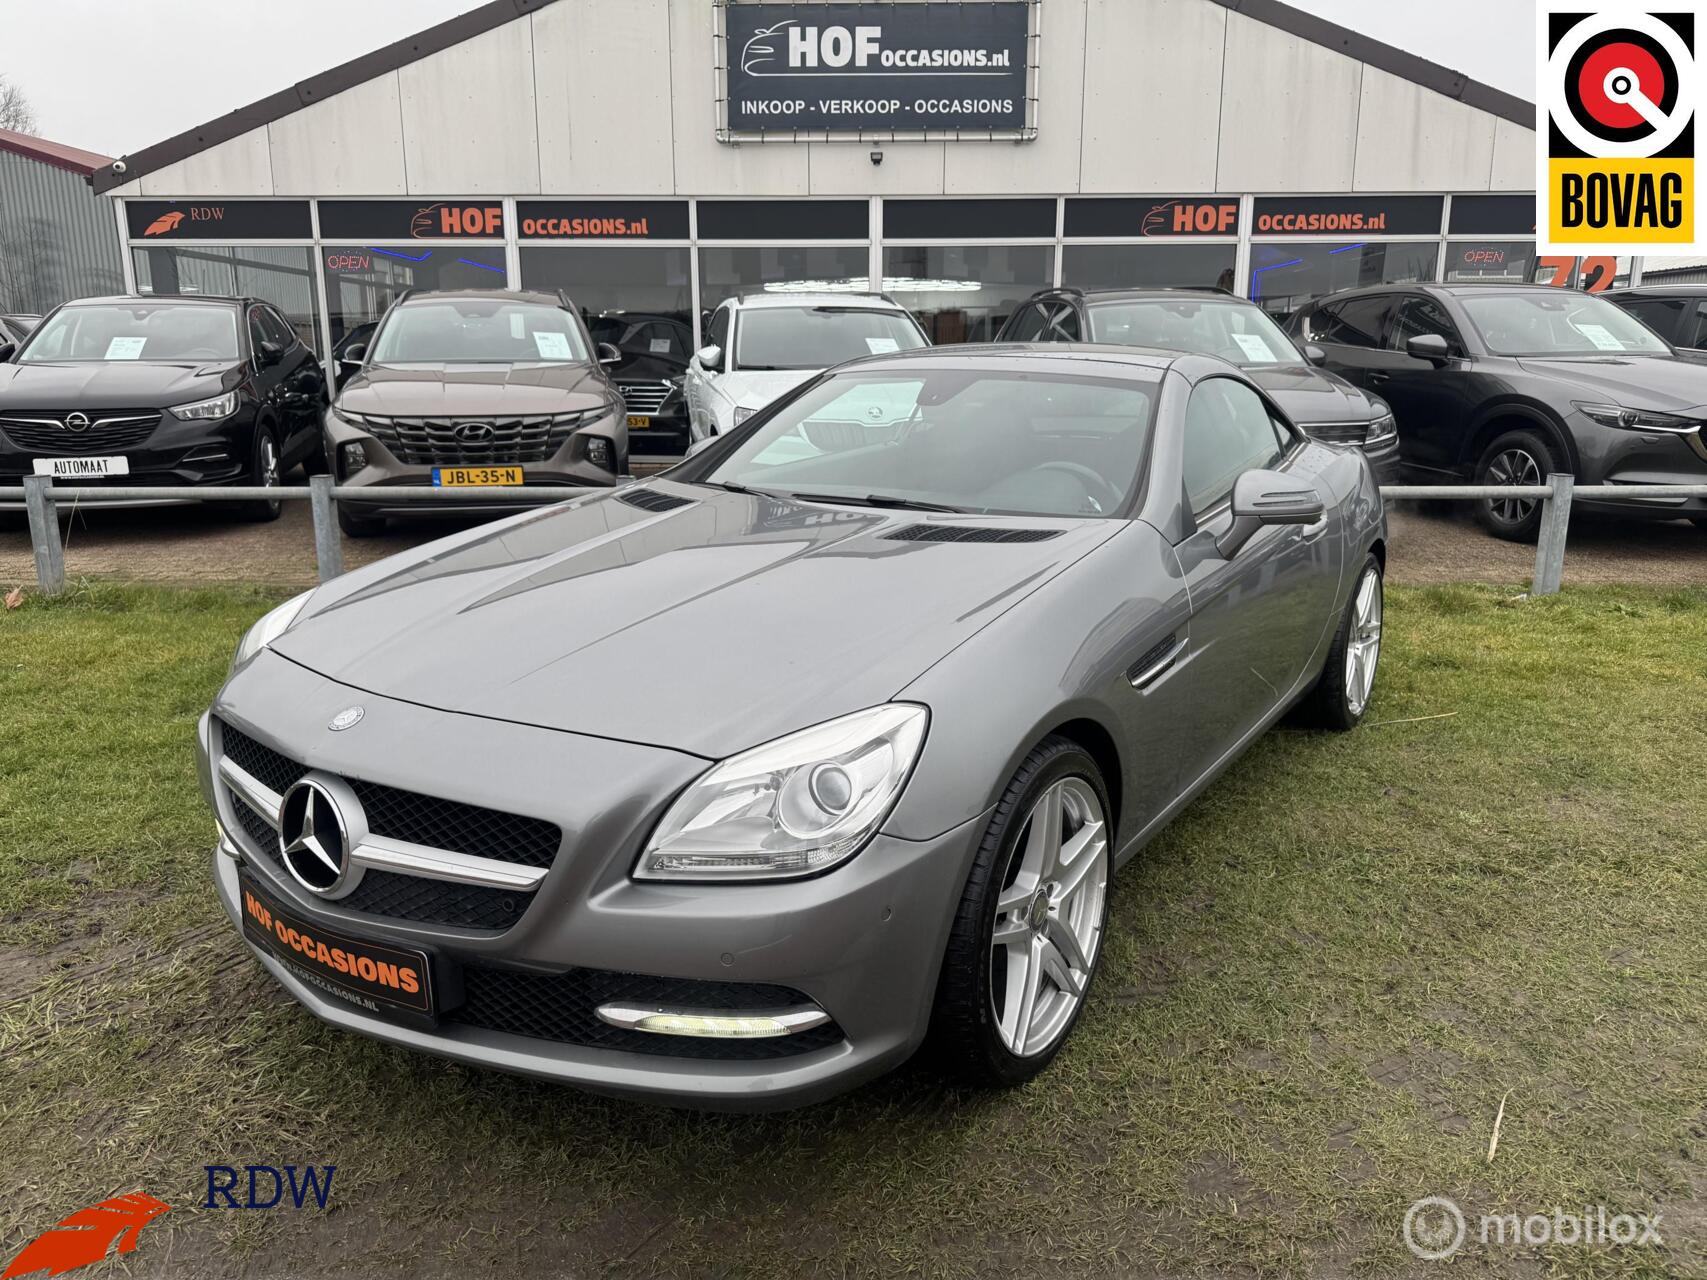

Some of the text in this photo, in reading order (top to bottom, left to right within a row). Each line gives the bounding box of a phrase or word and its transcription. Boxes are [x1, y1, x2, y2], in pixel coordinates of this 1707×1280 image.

[788, 26, 1010, 67] HOF OCCASIONS.nl
[741, 100, 805, 114] INKOOP
[819, 100, 900, 114] VERKOOP
[914, 99, 1013, 113] OCCASIONS
[190, 207, 224, 221] RDW
[440, 207, 649, 235] HOF OCCASIONS.nl
[1173, 204, 1386, 232] HOF OCCASIONS.nl
[328, 255, 370, 271] OPEN
[1464, 250, 1505, 263] OPEN
[54, 460, 109, 475] AUTOMAAT
[447, 469, 516, 485] JBL-35-N
[245, 890, 420, 994] HOF OCCASIONS
